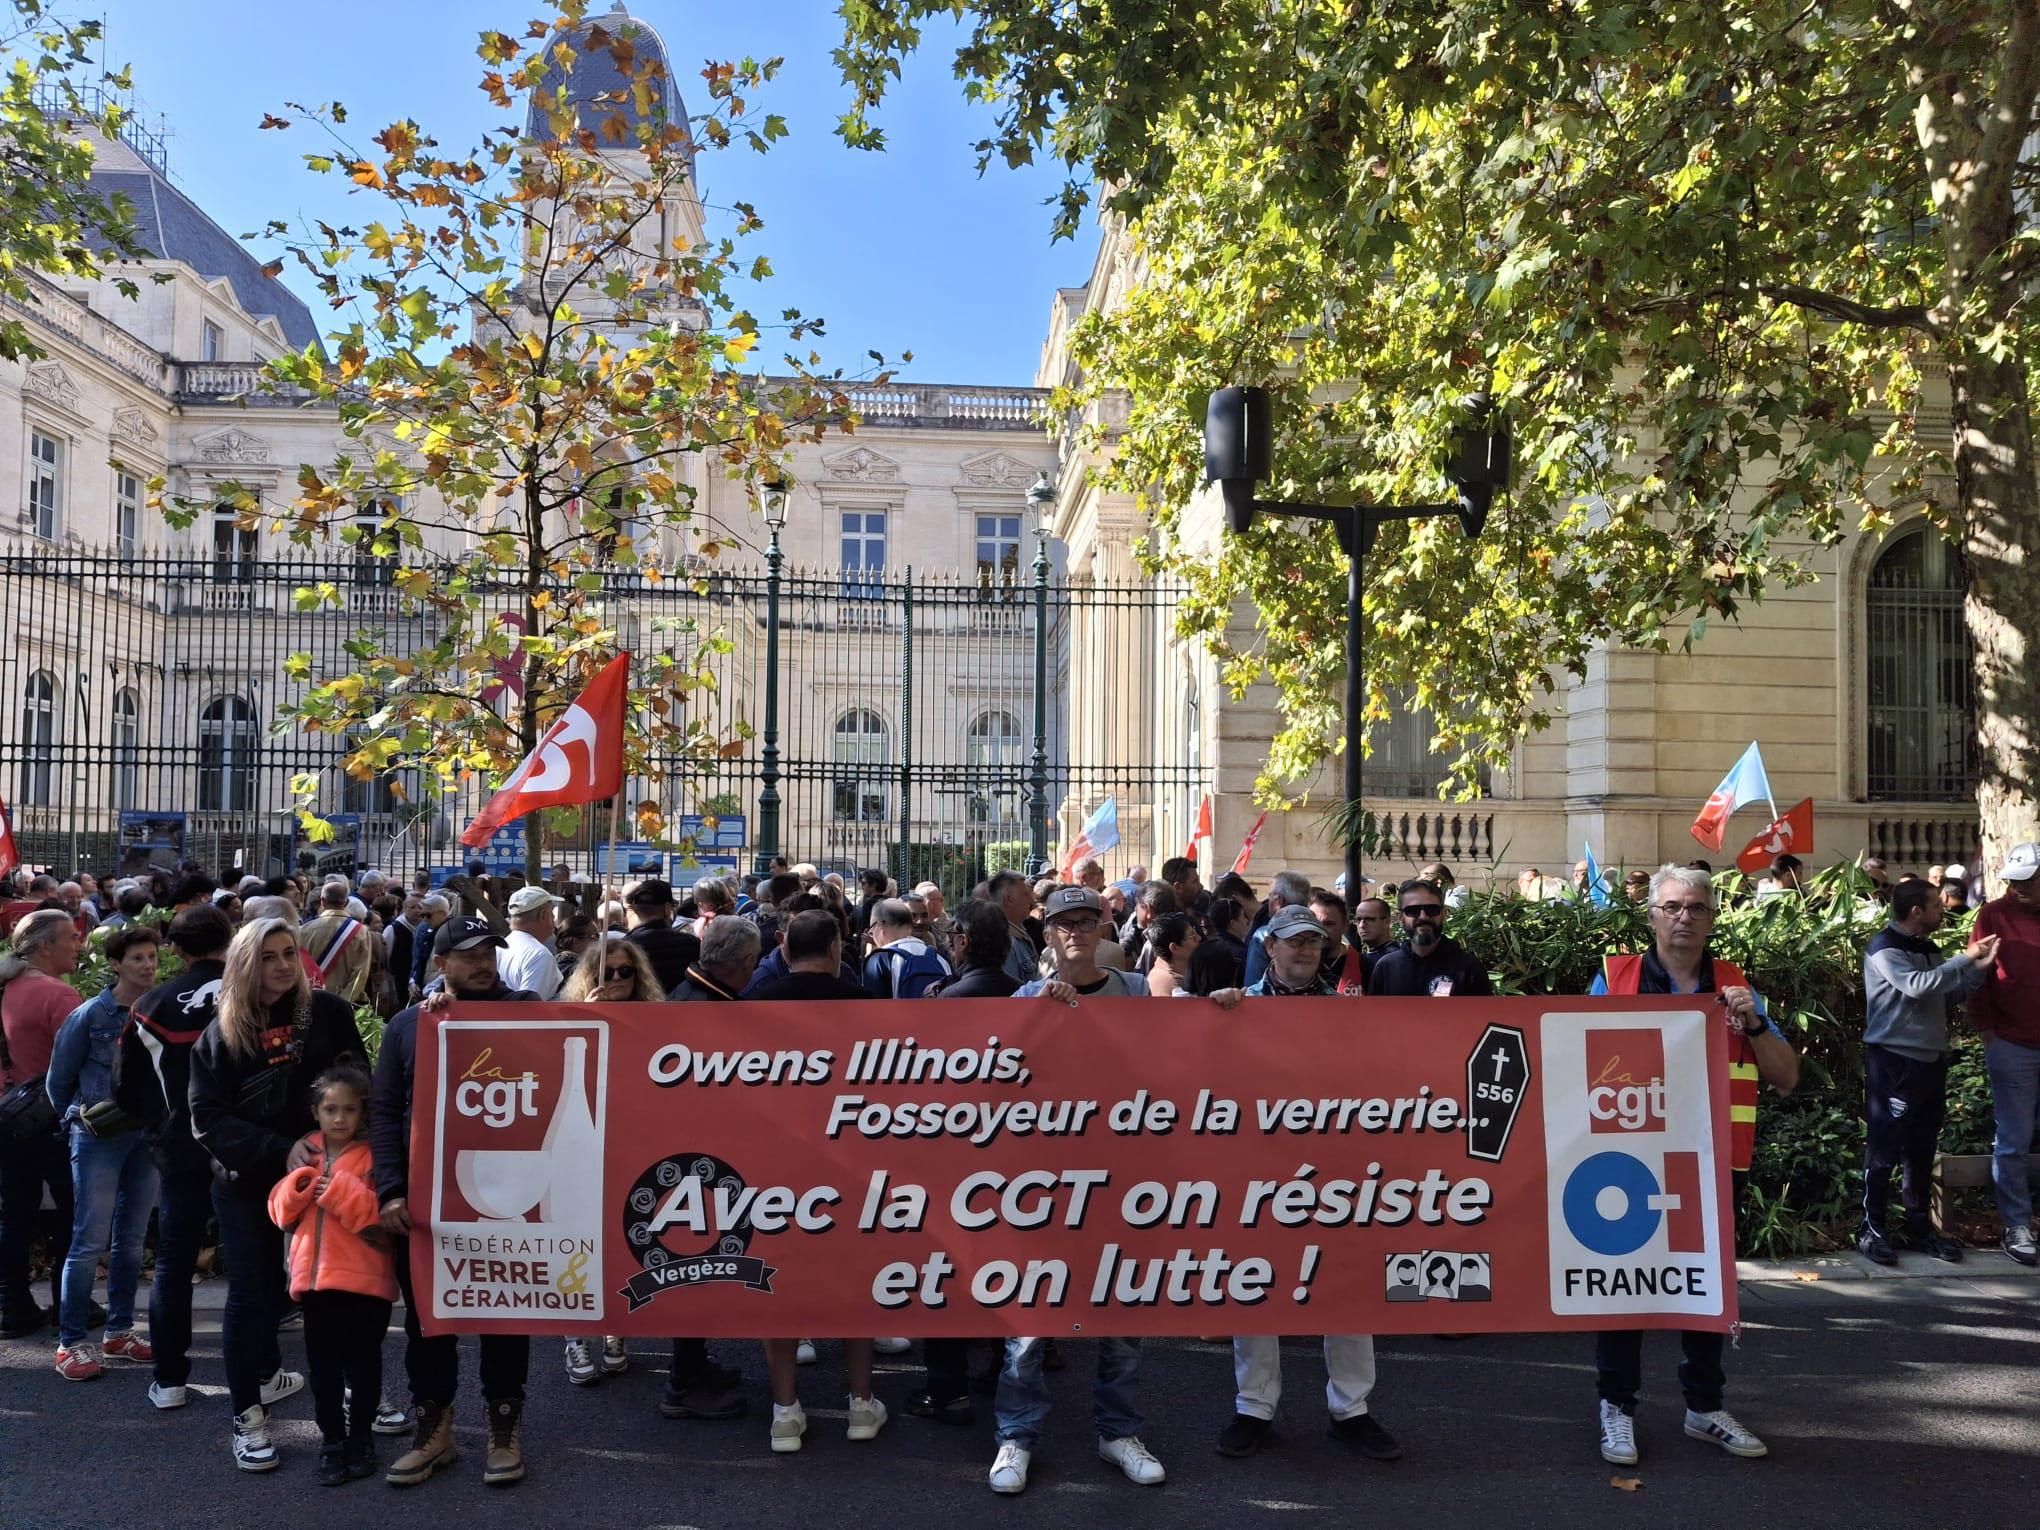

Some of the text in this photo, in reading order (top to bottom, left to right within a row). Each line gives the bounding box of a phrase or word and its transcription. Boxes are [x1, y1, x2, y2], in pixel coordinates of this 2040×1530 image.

[460, 1047, 539, 1081] la
[648, 1036, 1031, 1085] Owens Illinois,
[1592, 1055, 1664, 1086] la
[456, 1072, 538, 1128] cgt
[1476, 1082, 1514, 1104] 556
[1589, 1076, 1666, 1129] cgt
[825, 1085, 1489, 1144] Fossoyeur de la verrerie...
[647, 1162, 1490, 1231] Avec la CGT on résiste
[441, 1234, 594, 1255] FÉDÉRATION
[444, 1252, 588, 1294] VERRE &
[651, 1259, 738, 1285] Vergèze
[872, 1252, 953, 1305] et
[971, 1259, 1068, 1304] on
[1090, 1243, 1272, 1303] lutte
[1565, 1267, 1707, 1297] FRANCE
[442, 1284, 595, 1310] CÉRAMIQUE
